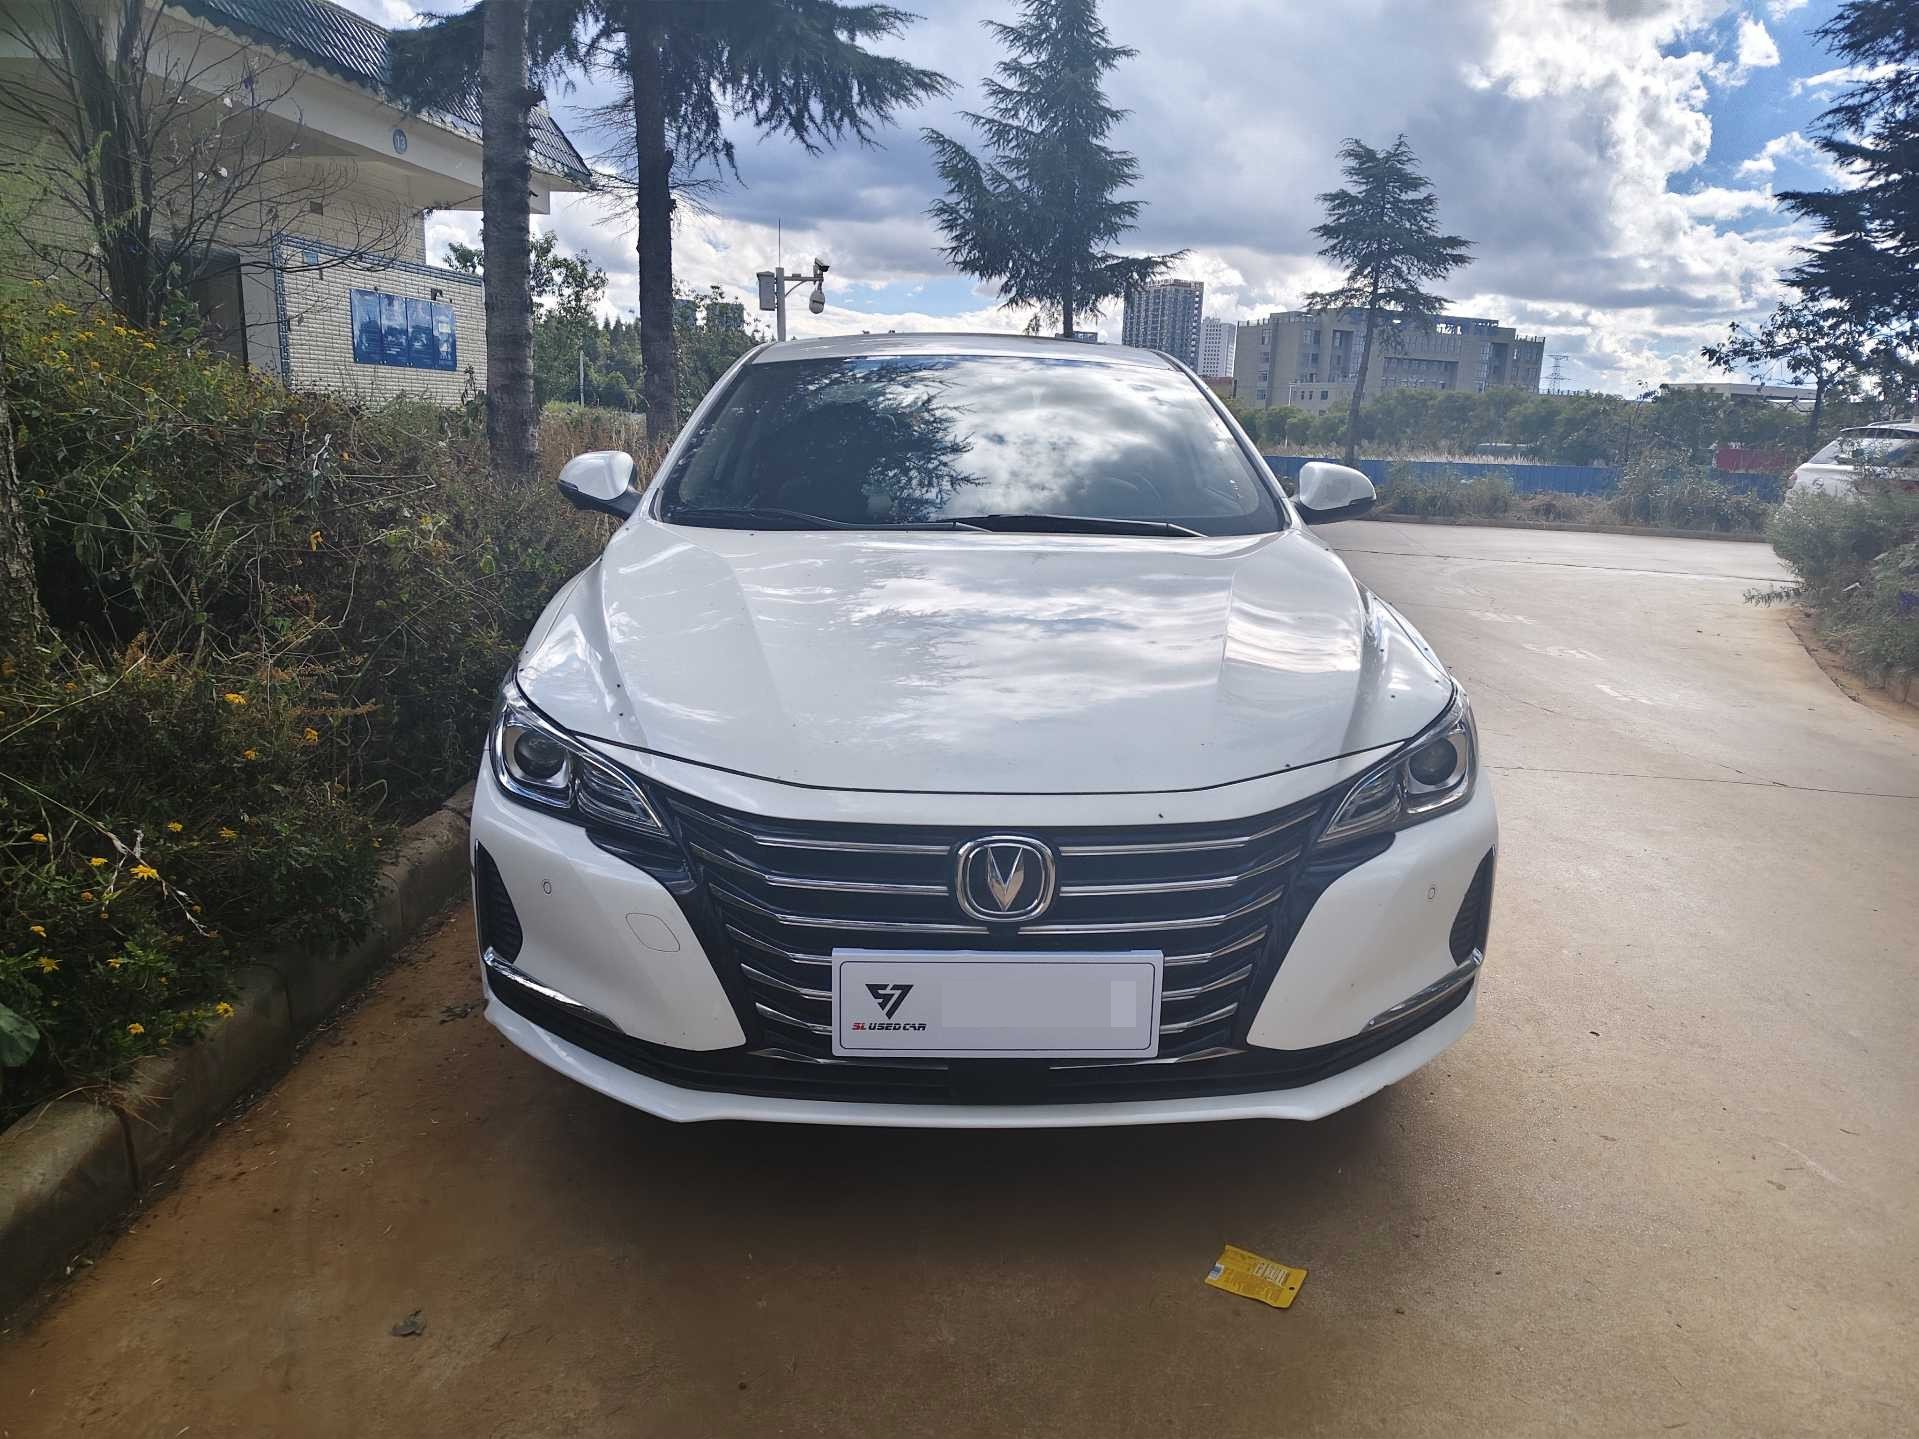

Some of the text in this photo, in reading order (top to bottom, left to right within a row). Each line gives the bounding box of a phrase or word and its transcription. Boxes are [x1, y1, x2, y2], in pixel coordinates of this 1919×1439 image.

[852, 1022, 927, 1031] SL USED CAR
